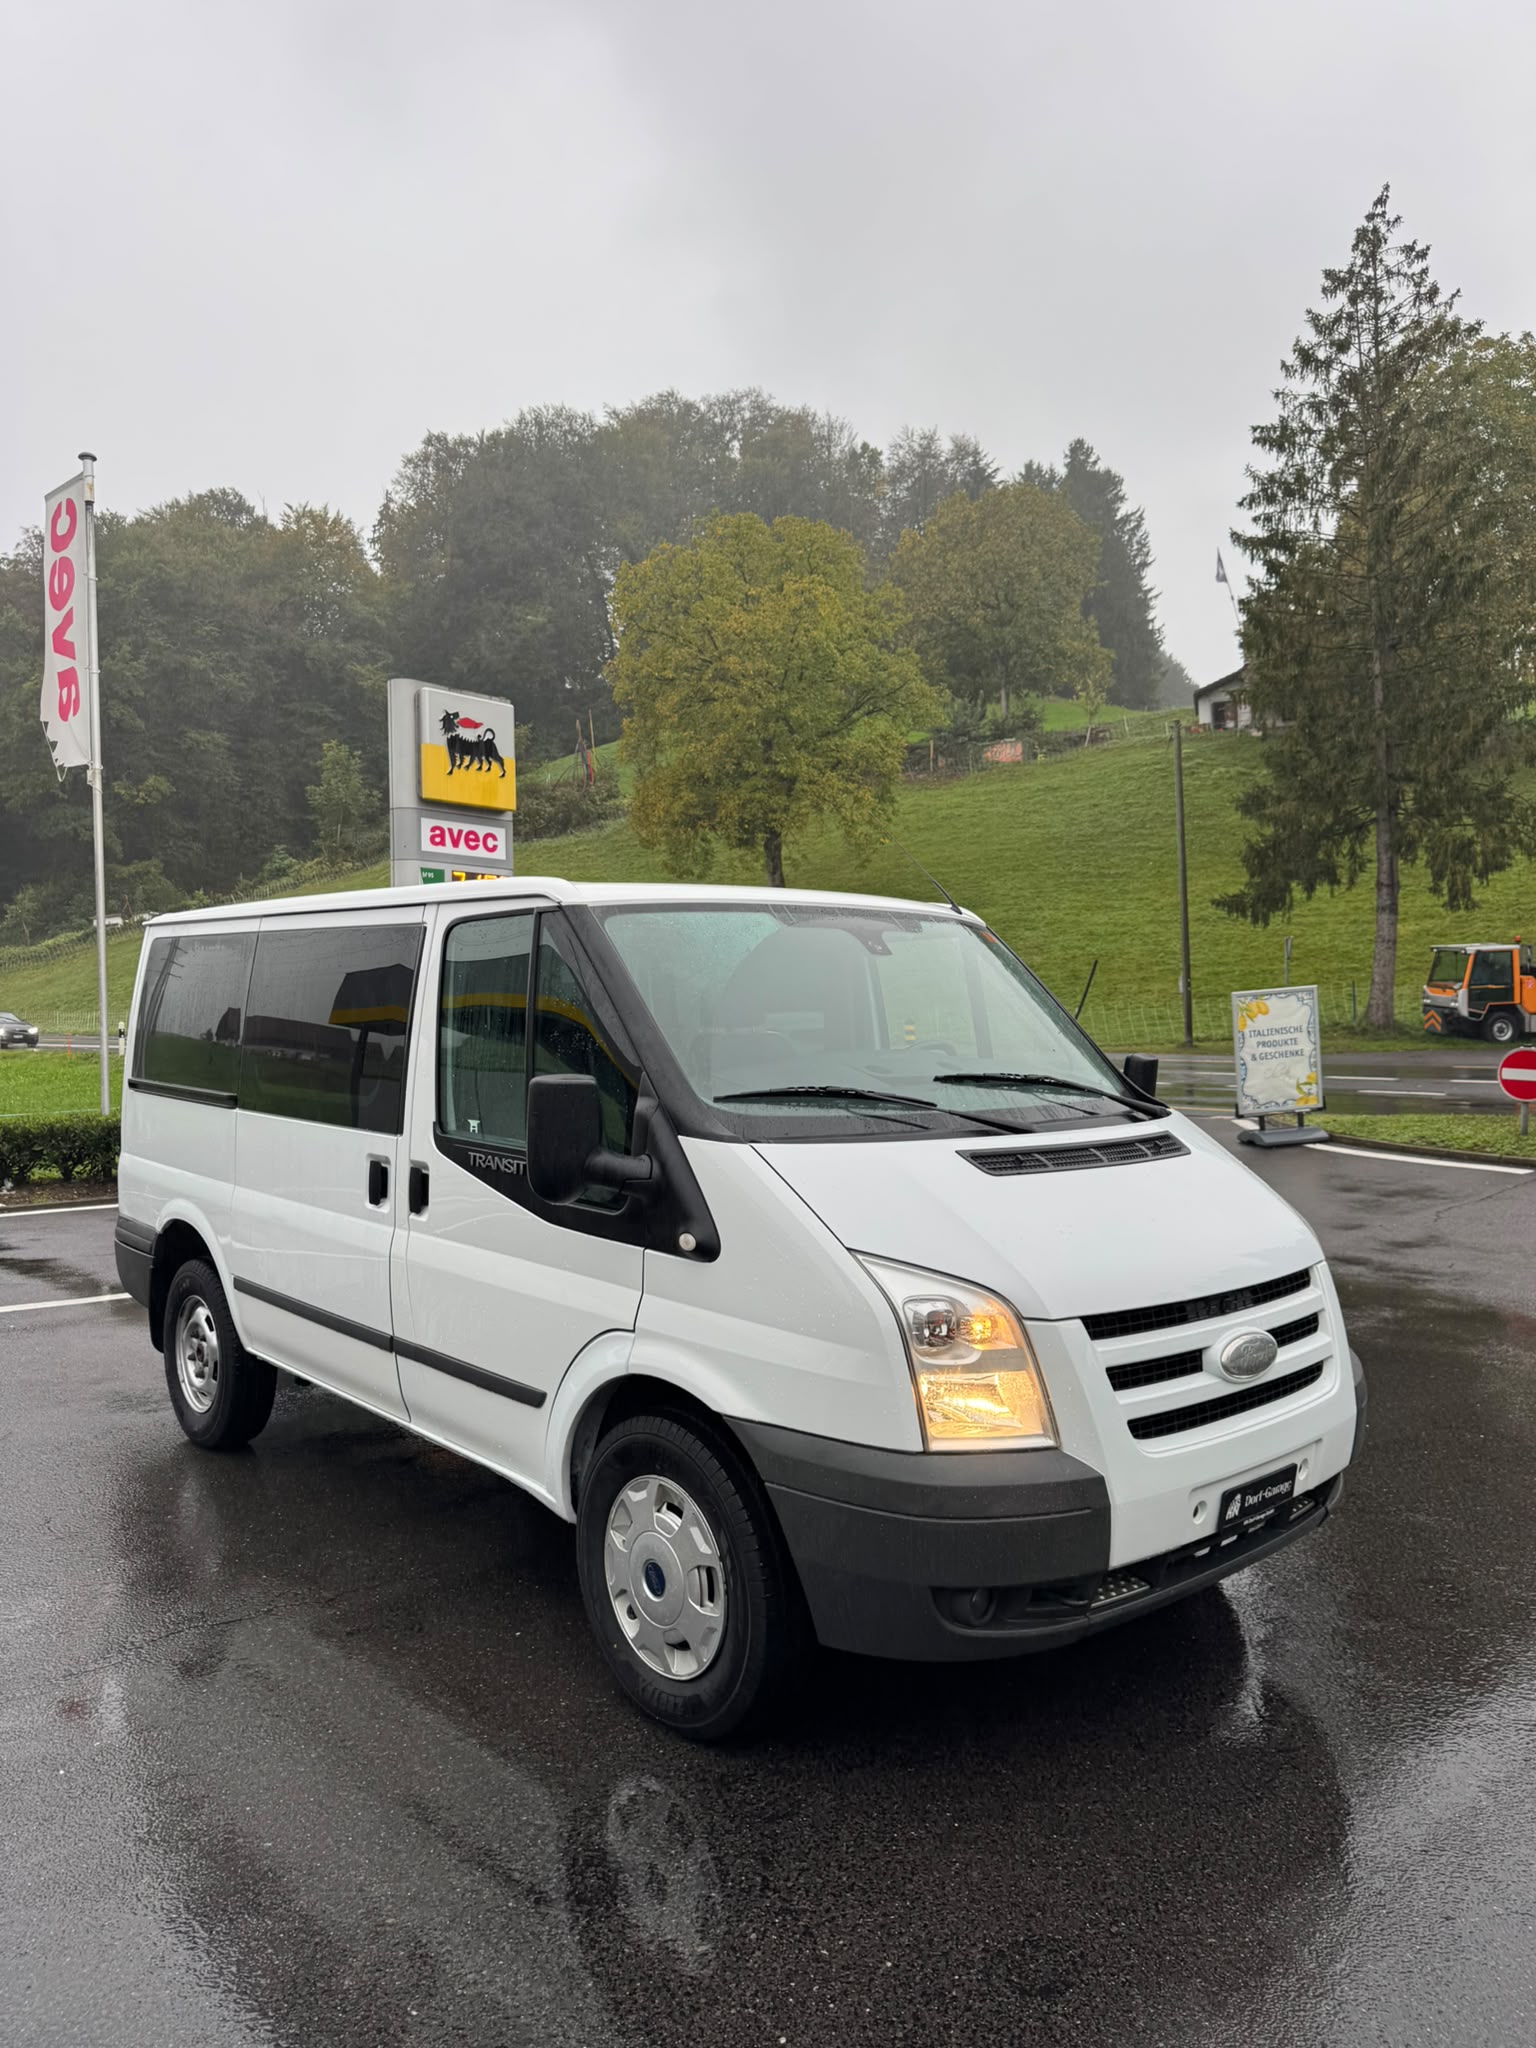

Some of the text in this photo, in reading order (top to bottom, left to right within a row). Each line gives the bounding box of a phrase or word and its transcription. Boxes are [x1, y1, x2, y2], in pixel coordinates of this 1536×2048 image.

[429, 825, 498, 853] avec
[1248, 1025, 1304, 1038] ITALIENISCHE
[1256, 1037, 1299, 1048] PRODUKTE
[1251, 1049, 1305, 1061] & GESCHENKE
[468, 1151, 527, 1175] TRANSIT
[1244, 1480, 1293, 1507] Dorf-Garage
